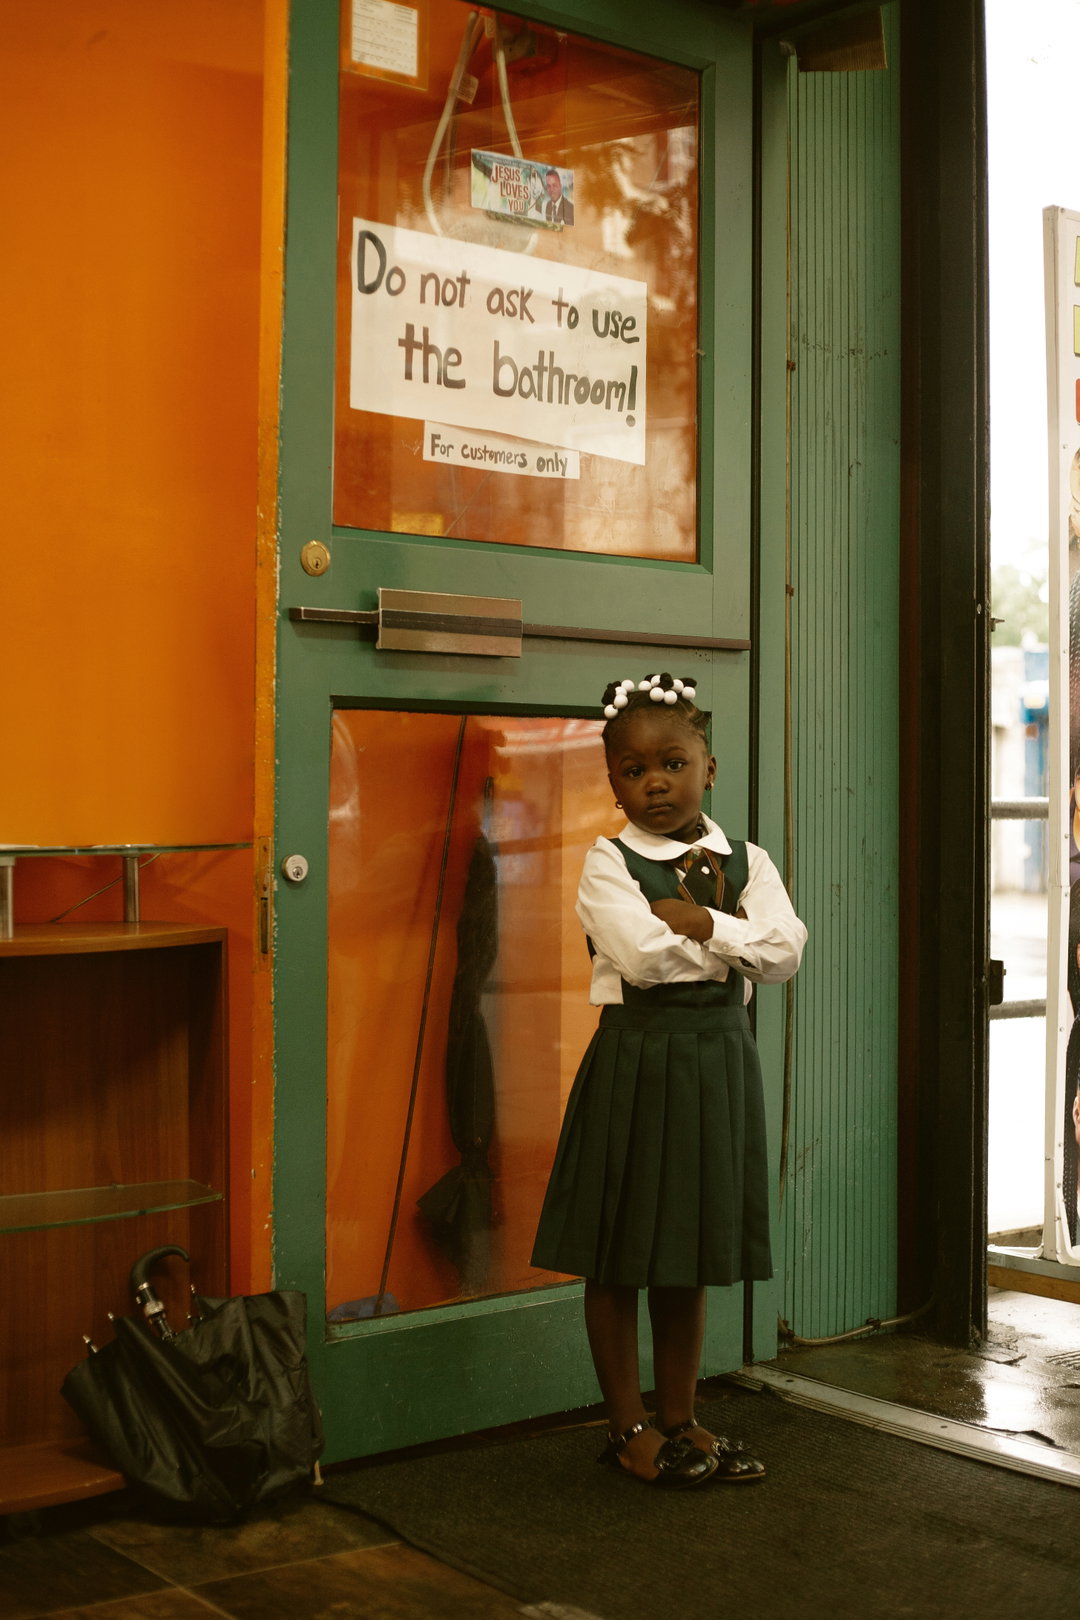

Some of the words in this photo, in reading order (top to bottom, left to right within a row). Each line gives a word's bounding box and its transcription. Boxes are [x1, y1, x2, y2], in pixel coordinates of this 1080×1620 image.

[491, 165, 521, 184] JESUS
[500, 180, 529, 200] LOVES
[507, 199, 525, 213] YOU
[357, 229, 406, 296] Do
[419, 269, 471, 308] not
[551, 287, 579, 330] to
[592, 308, 640, 344] use
[398, 322, 466, 389] the
[492, 339, 639, 428] bathroom!
[430, 433, 455, 457] For
[460, 443, 528, 469] customers
[536, 452, 568, 477] only
